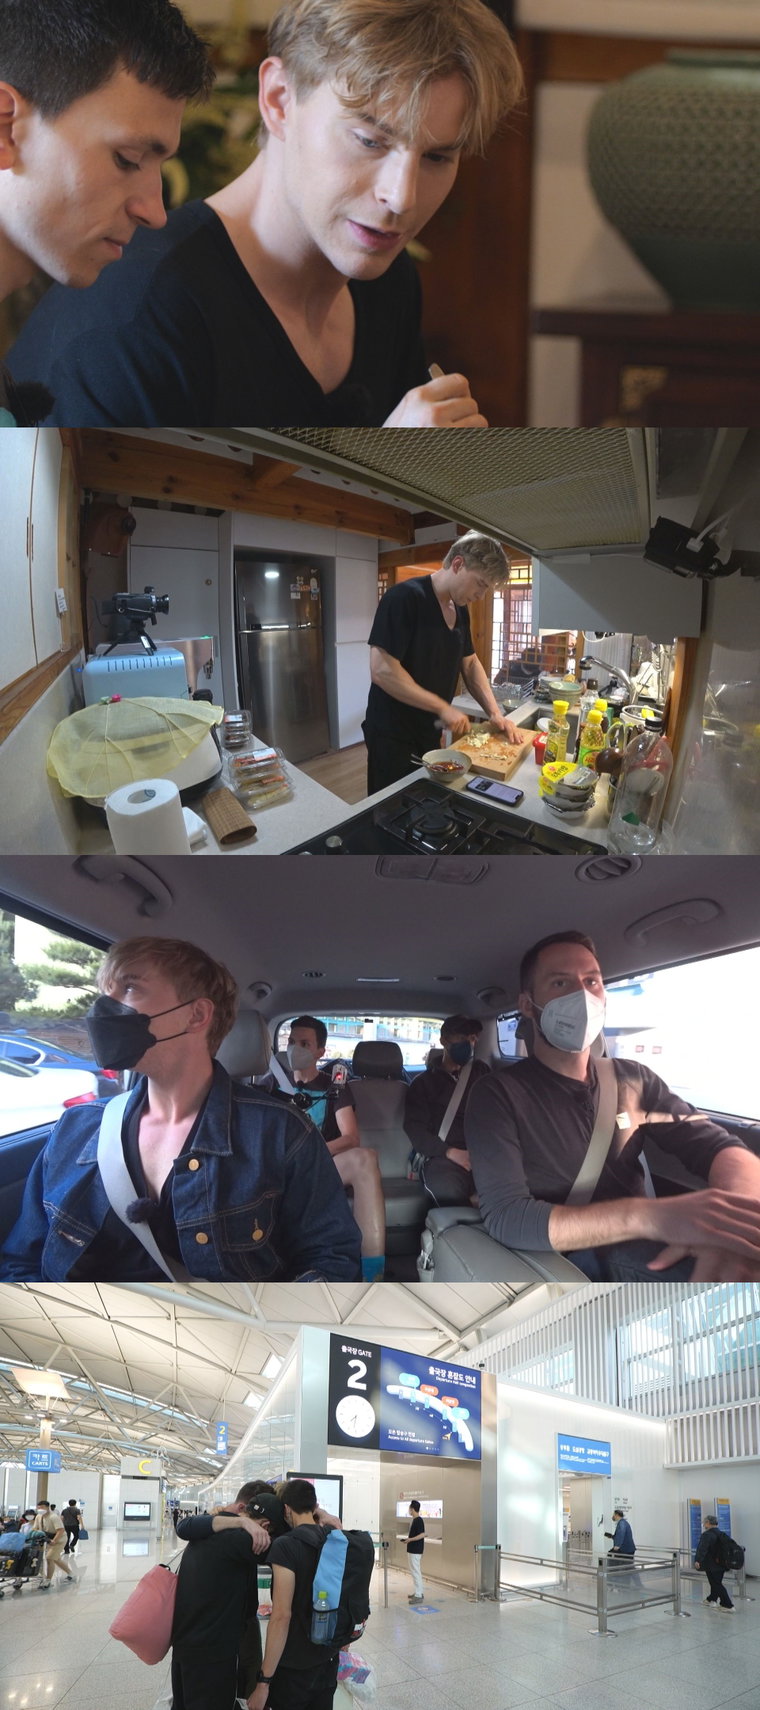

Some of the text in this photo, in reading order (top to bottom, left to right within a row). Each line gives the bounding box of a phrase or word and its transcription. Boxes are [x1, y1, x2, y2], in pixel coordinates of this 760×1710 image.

[358, 1350, 372, 1358] GATE
[347, 1359, 367, 1390] 2
[429, 1366, 446, 1377] 출국장
[465, 1375, 476, 1384] 안내
[219, 1426, 226, 1434] 2
[138, 1460, 152, 1475] C
